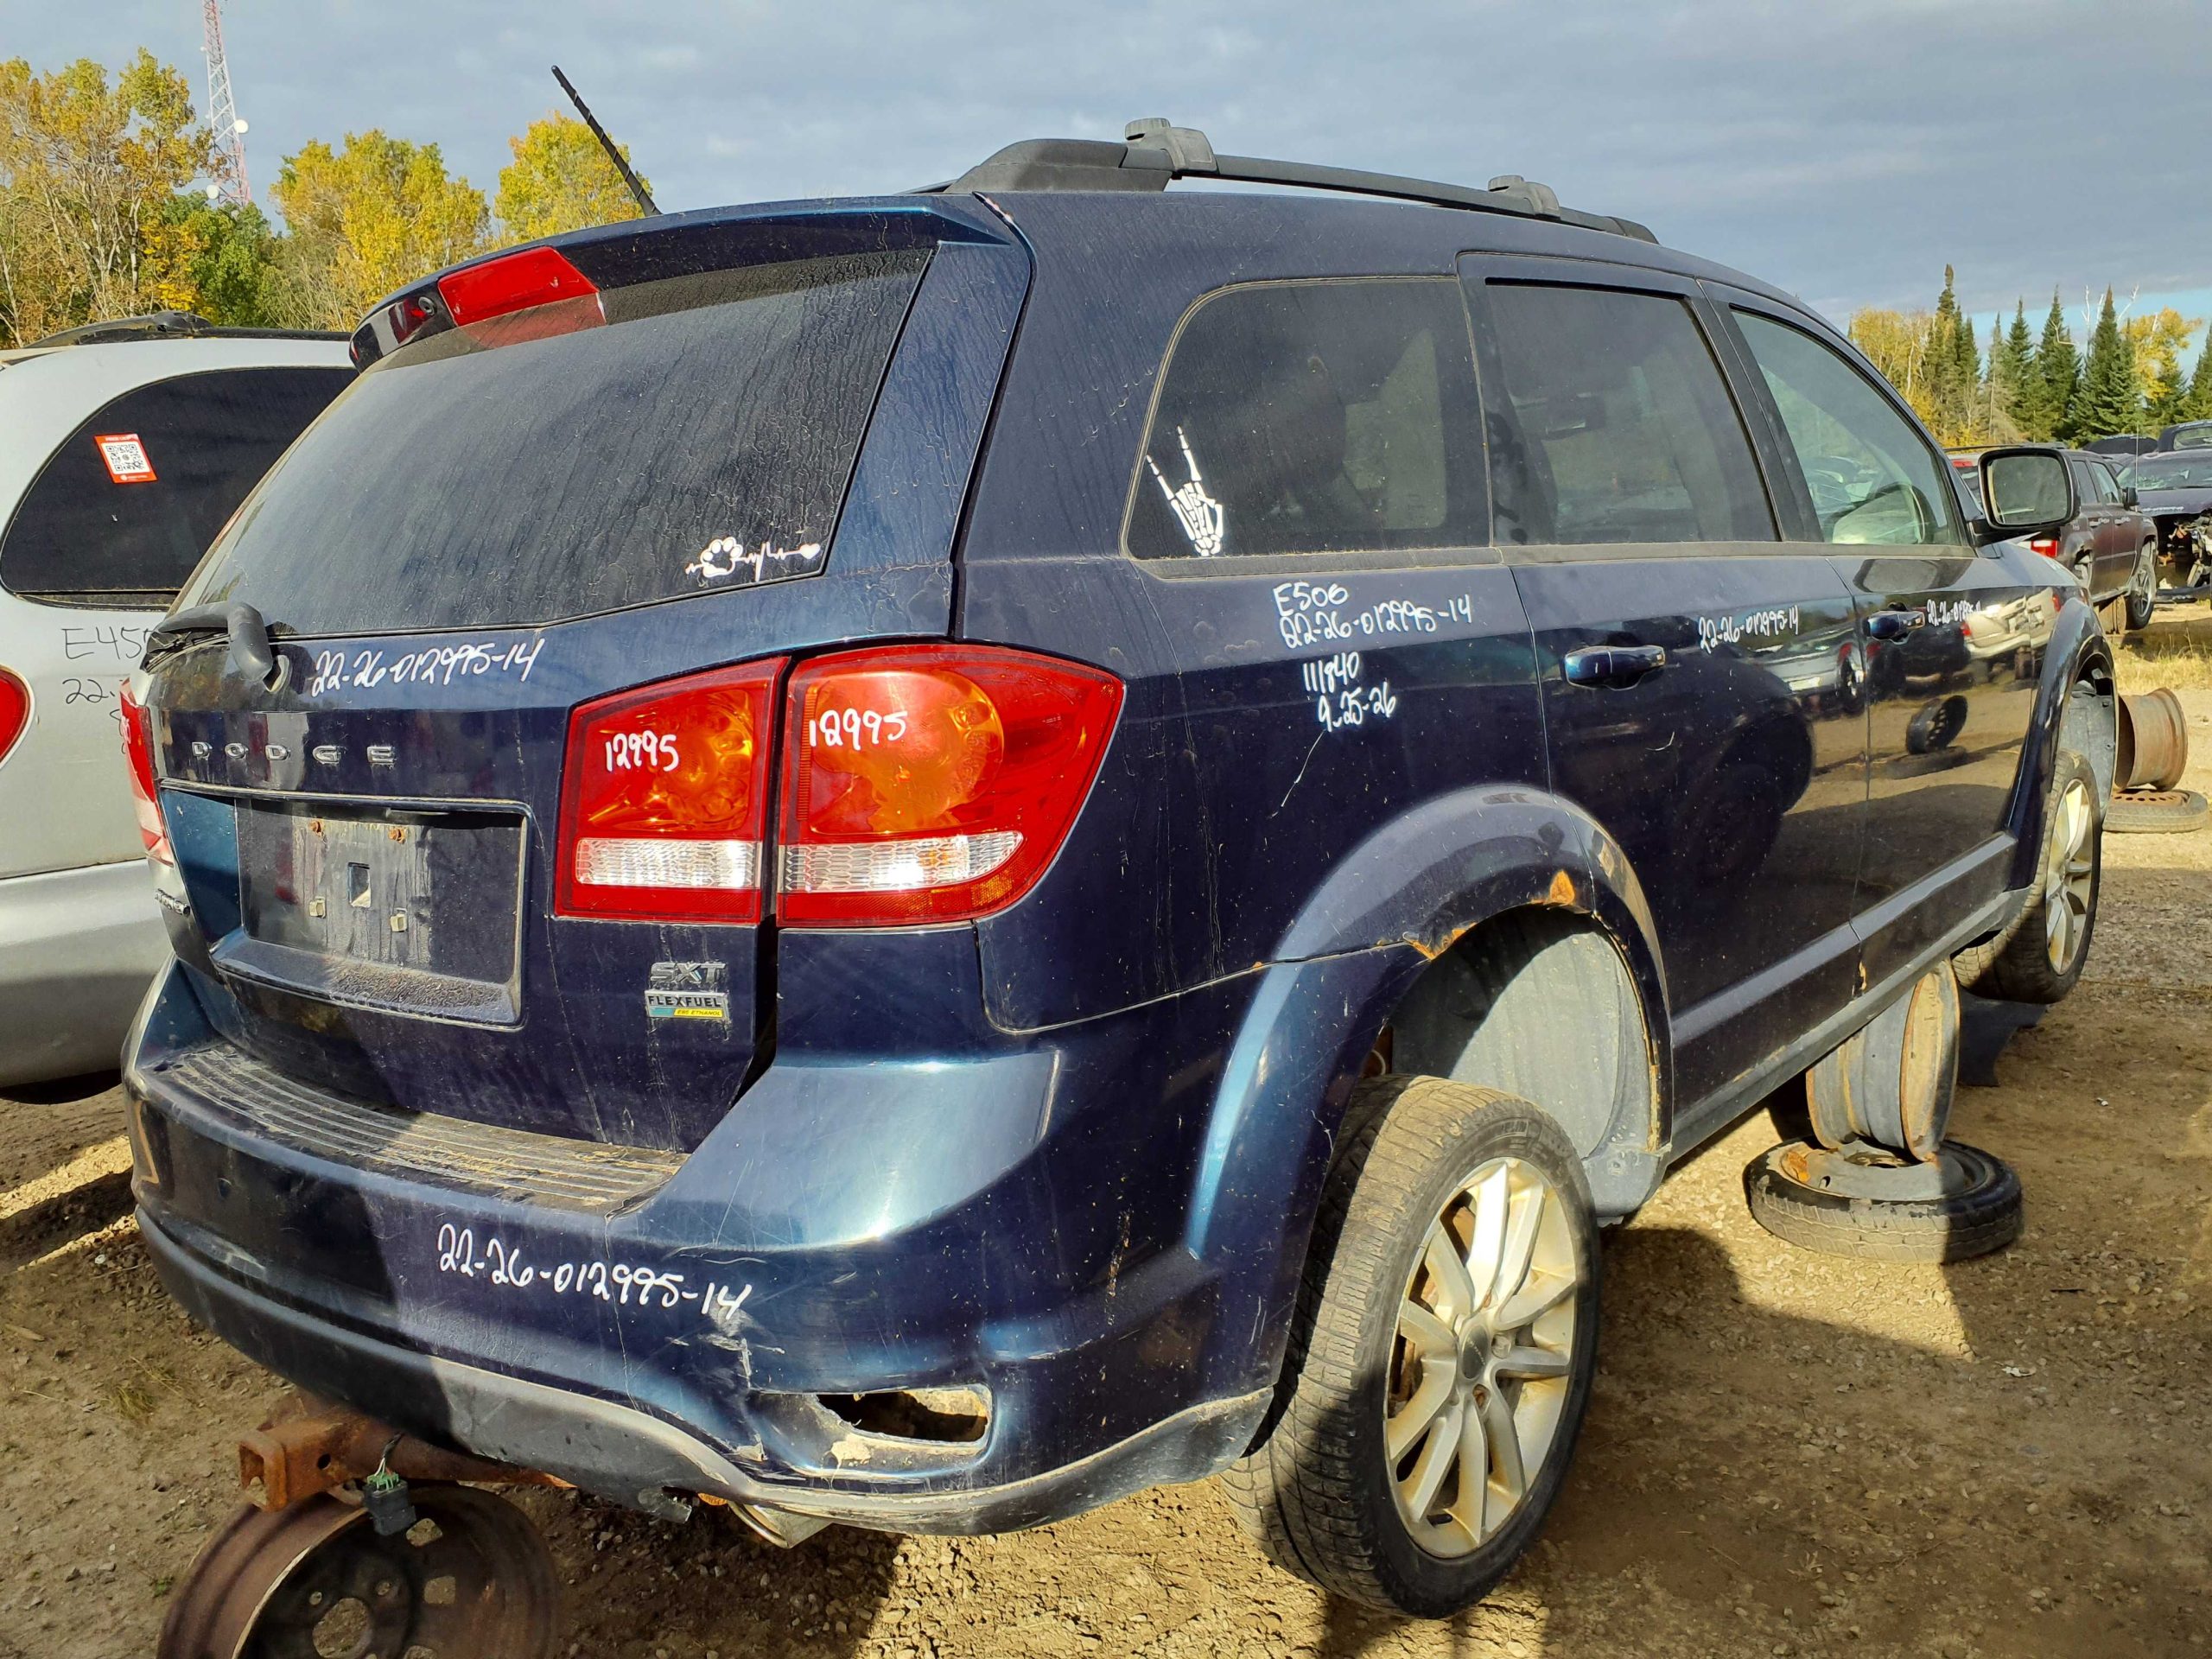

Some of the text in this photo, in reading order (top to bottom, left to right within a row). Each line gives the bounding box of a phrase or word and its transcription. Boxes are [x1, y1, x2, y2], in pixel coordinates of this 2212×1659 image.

[1280, 594, 1472, 649] 22-26-012995-14
[312, 639, 545, 697] 22-26-012995-14
[605, 730, 679, 772] 12995
[809, 708, 909, 752] 12995
[191, 741, 397, 765] DODGE
[651, 962, 726, 982] SXT
[648, 995, 721, 1007] FLEXFUEL
[437, 1224, 753, 1320] 22-26-012995-14
